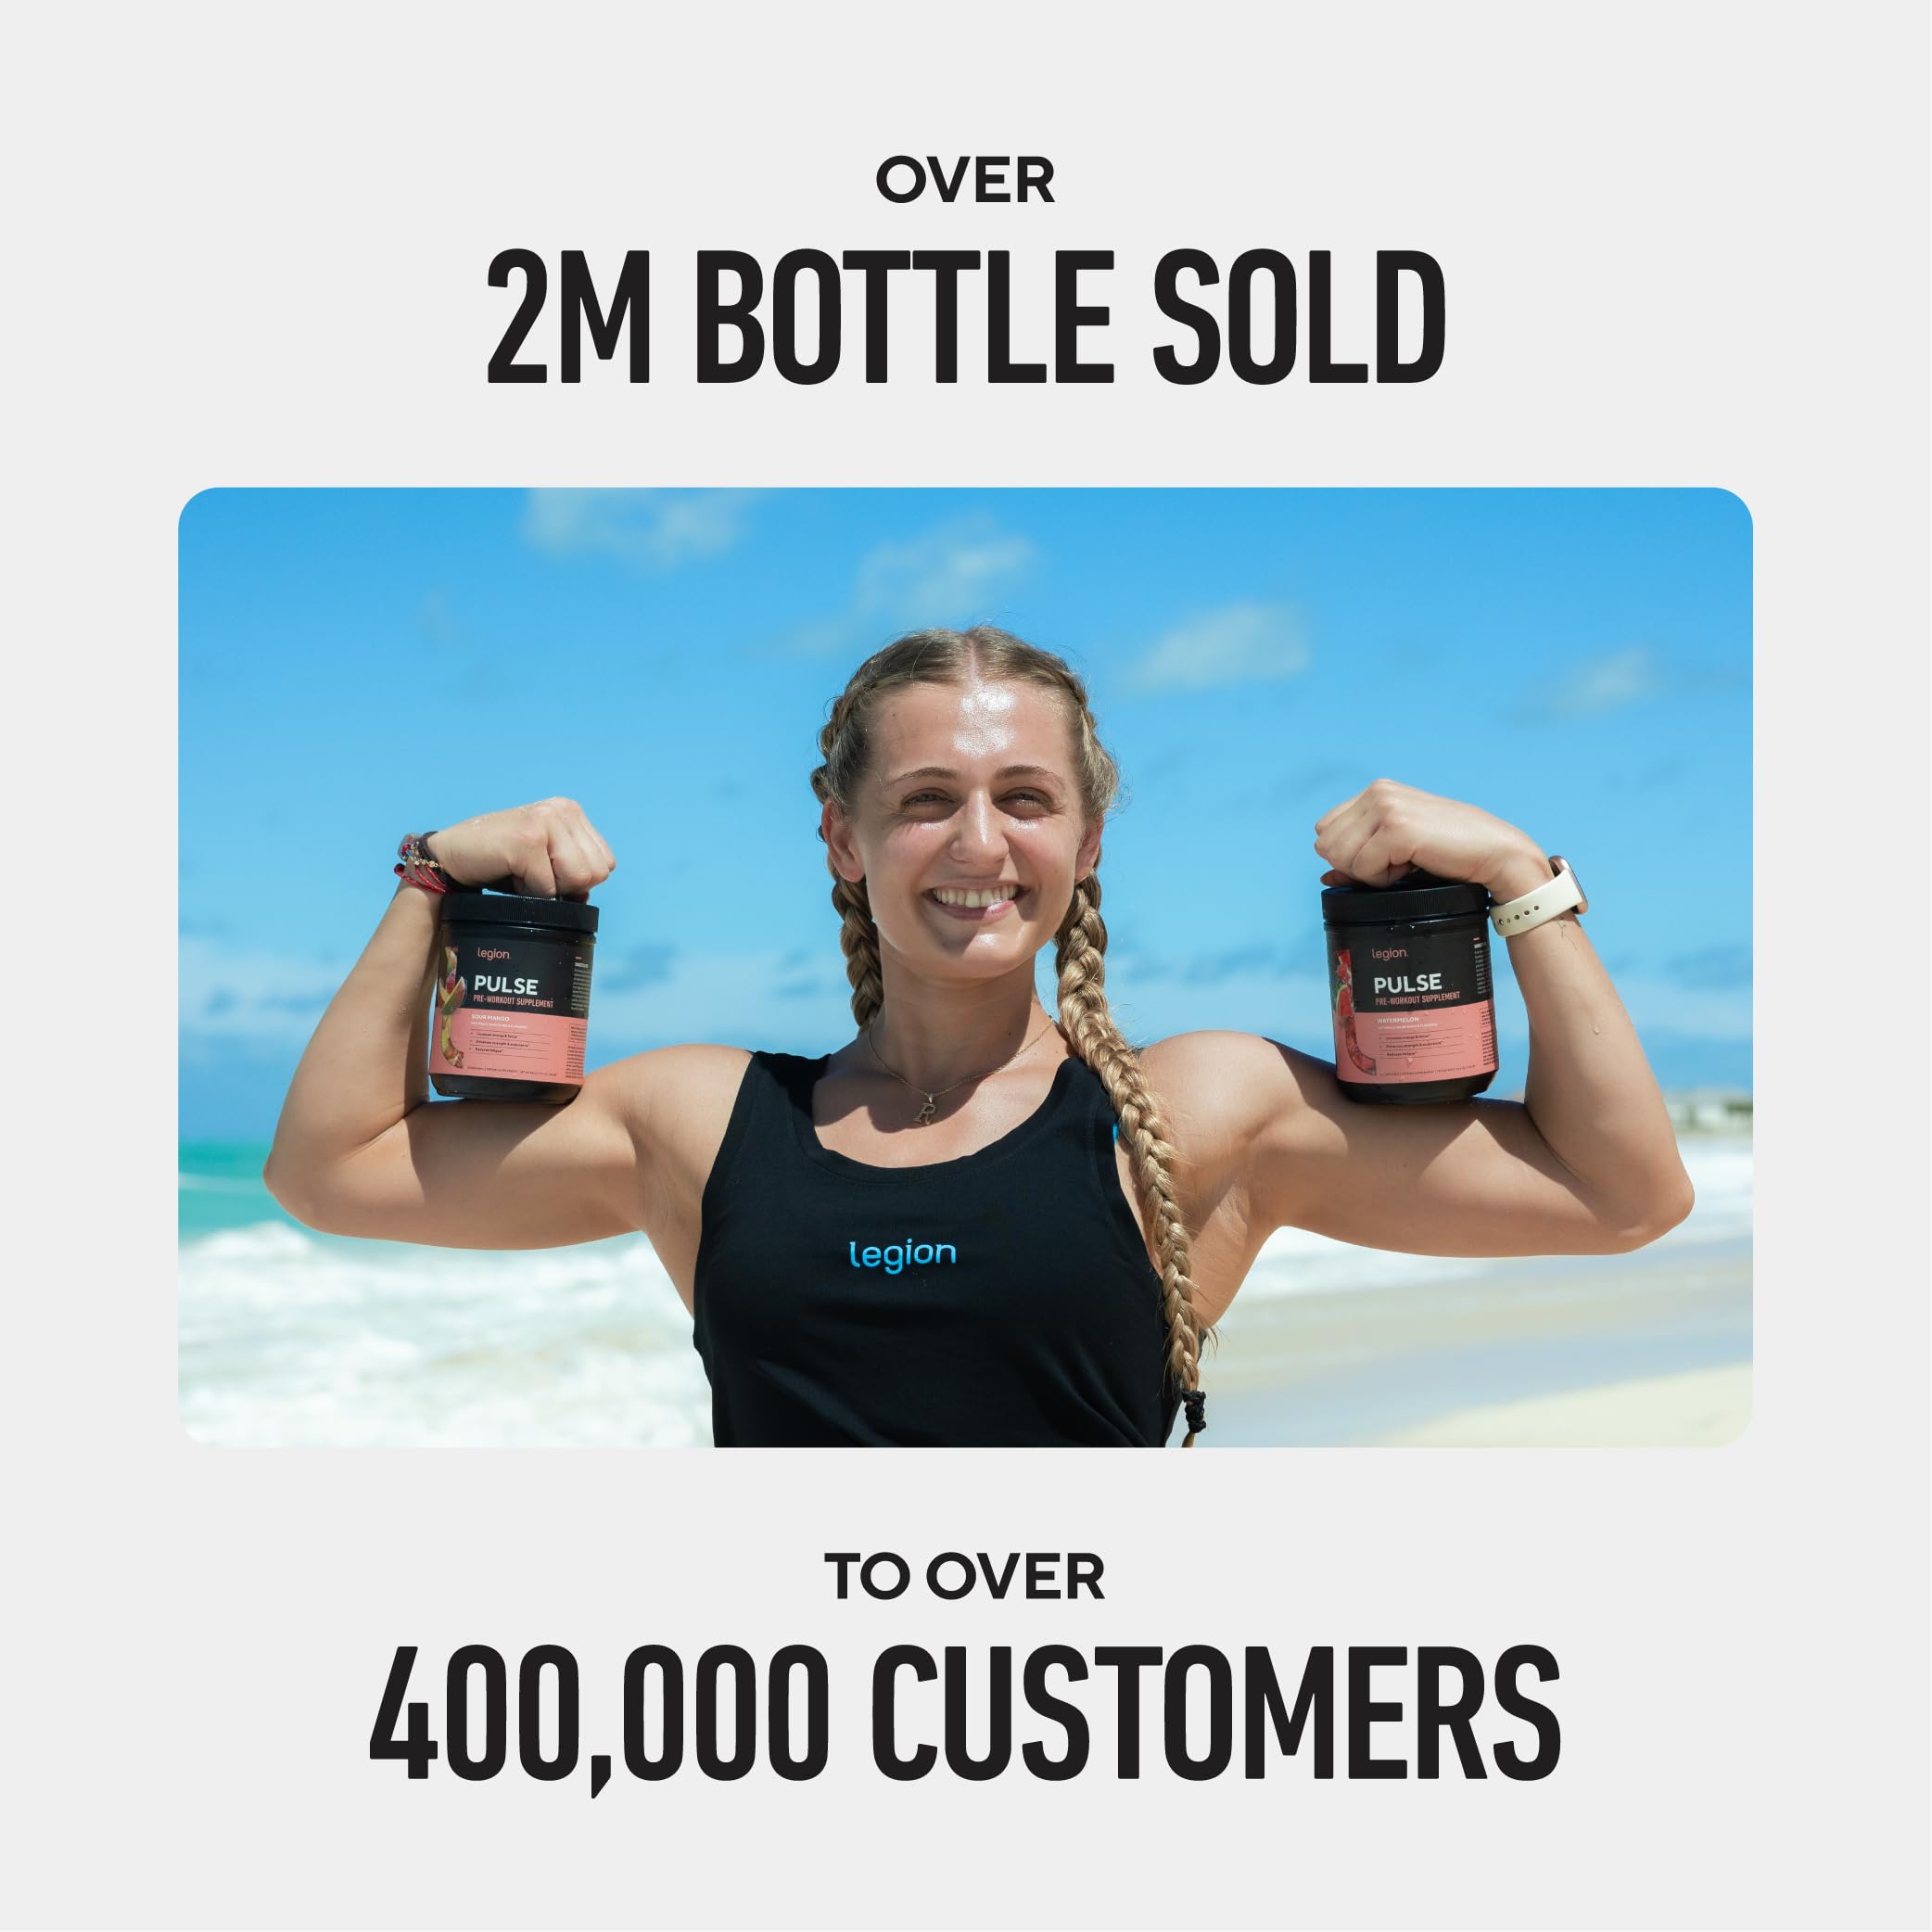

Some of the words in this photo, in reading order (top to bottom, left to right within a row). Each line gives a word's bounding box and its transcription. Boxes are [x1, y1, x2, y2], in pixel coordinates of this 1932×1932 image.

[474, 974, 539, 996] PULSE
[1374, 972, 1443, 994] PULSE
[473, 994, 515, 1005] PRE-WORKOUT
[516, 998, 553, 1009] SUPPLEMENT
[1375, 996, 1420, 1006] PRE-WORKOUT
[1421, 991, 1461, 1003] SUPPLEMENT
[849, 1238, 957, 1275] legion
